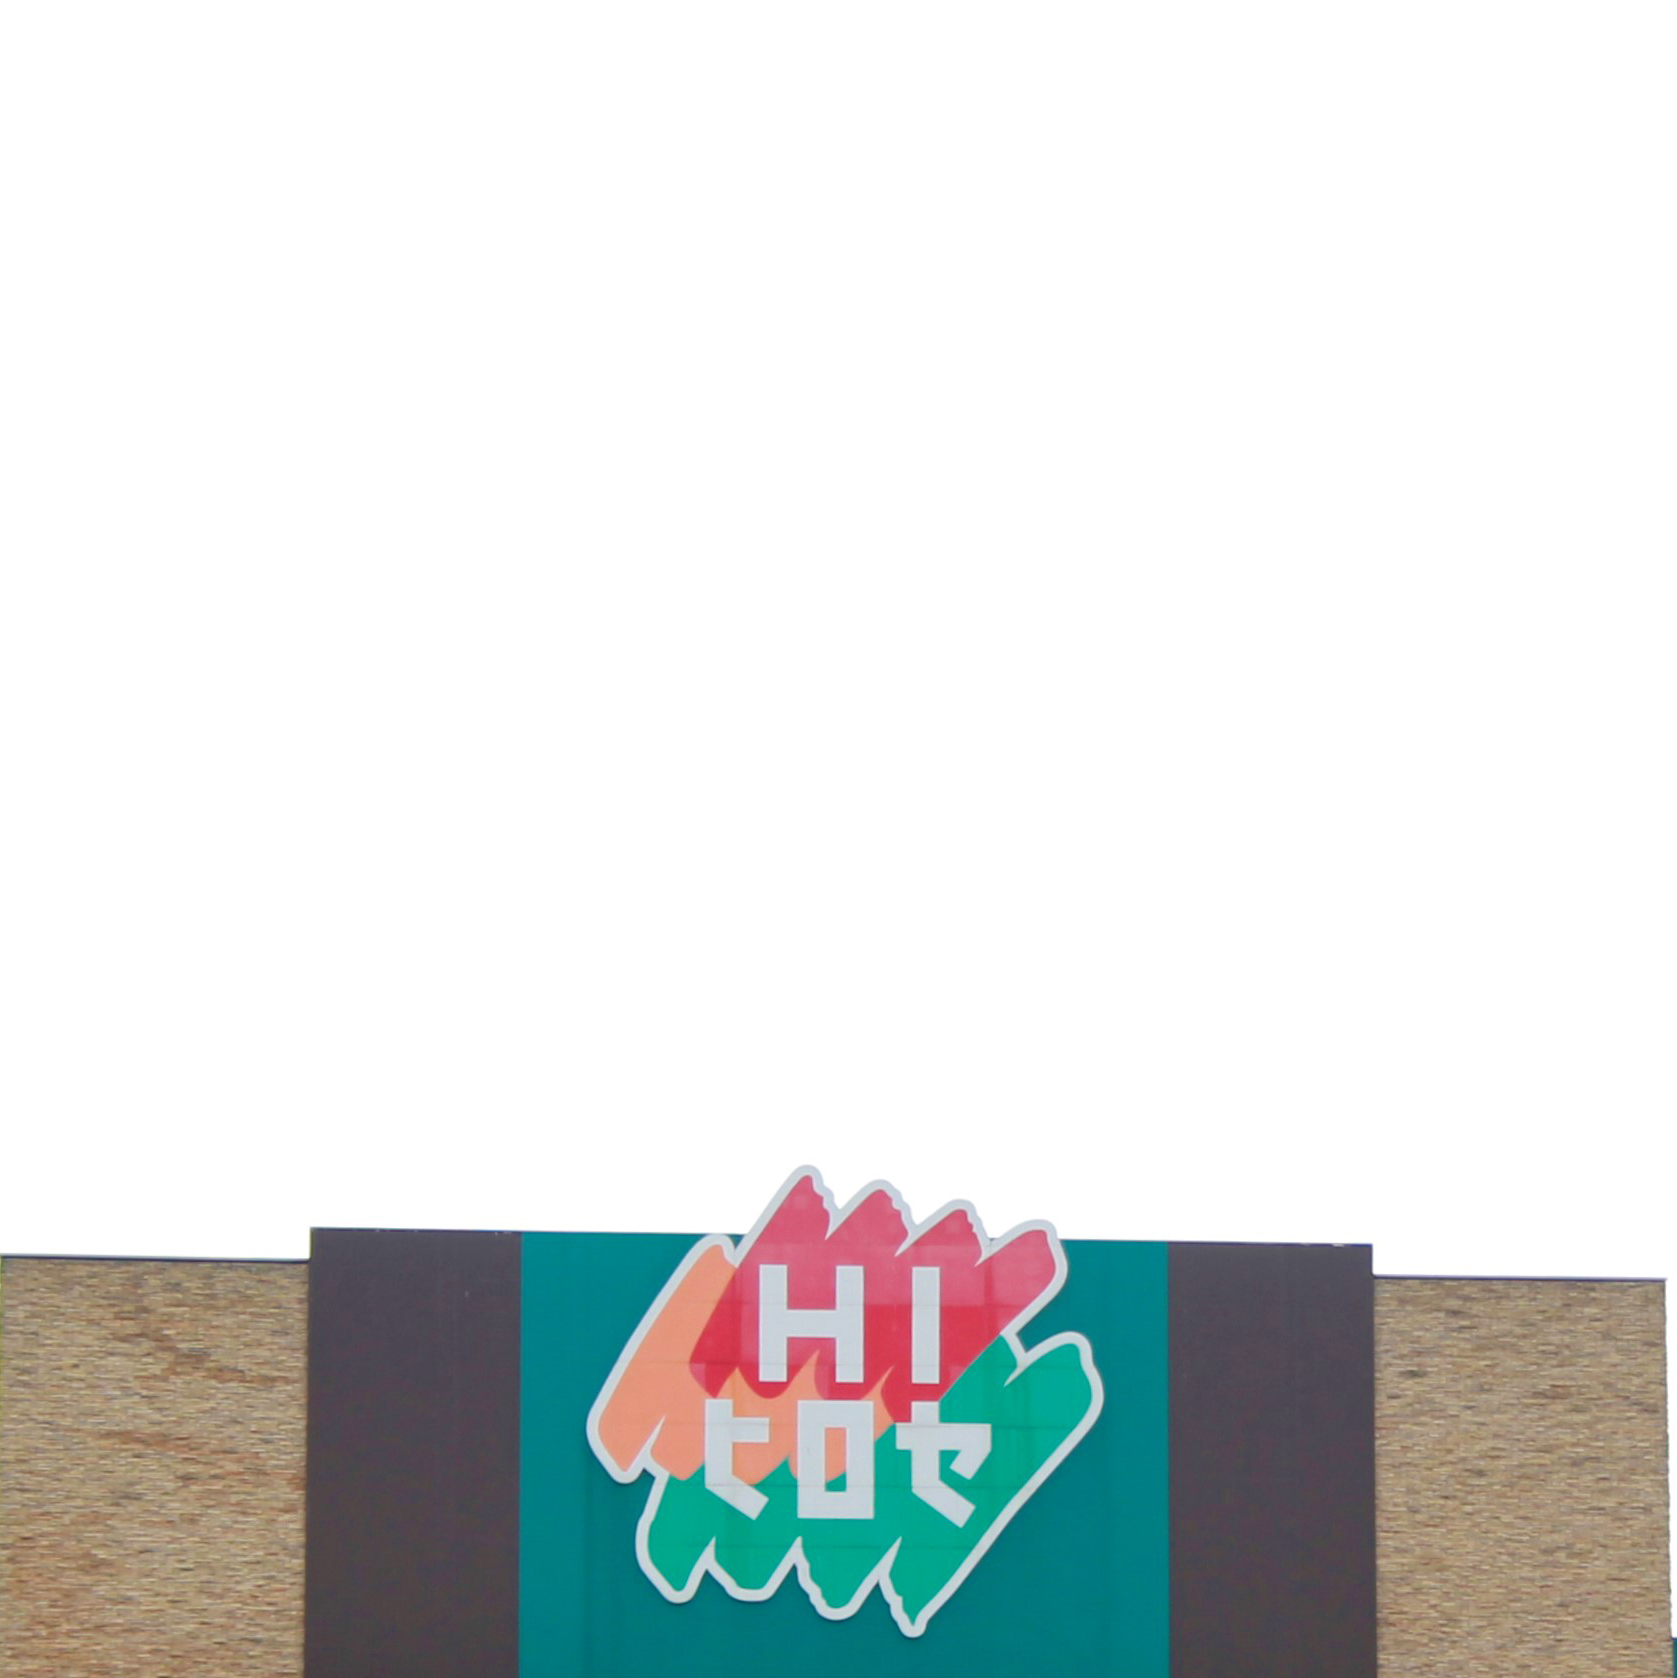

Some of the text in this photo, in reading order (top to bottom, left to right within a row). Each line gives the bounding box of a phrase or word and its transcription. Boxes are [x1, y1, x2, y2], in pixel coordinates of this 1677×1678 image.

[758, 1263, 940, 1384] HI
[704, 1398, 992, 1529] ヒロセ
